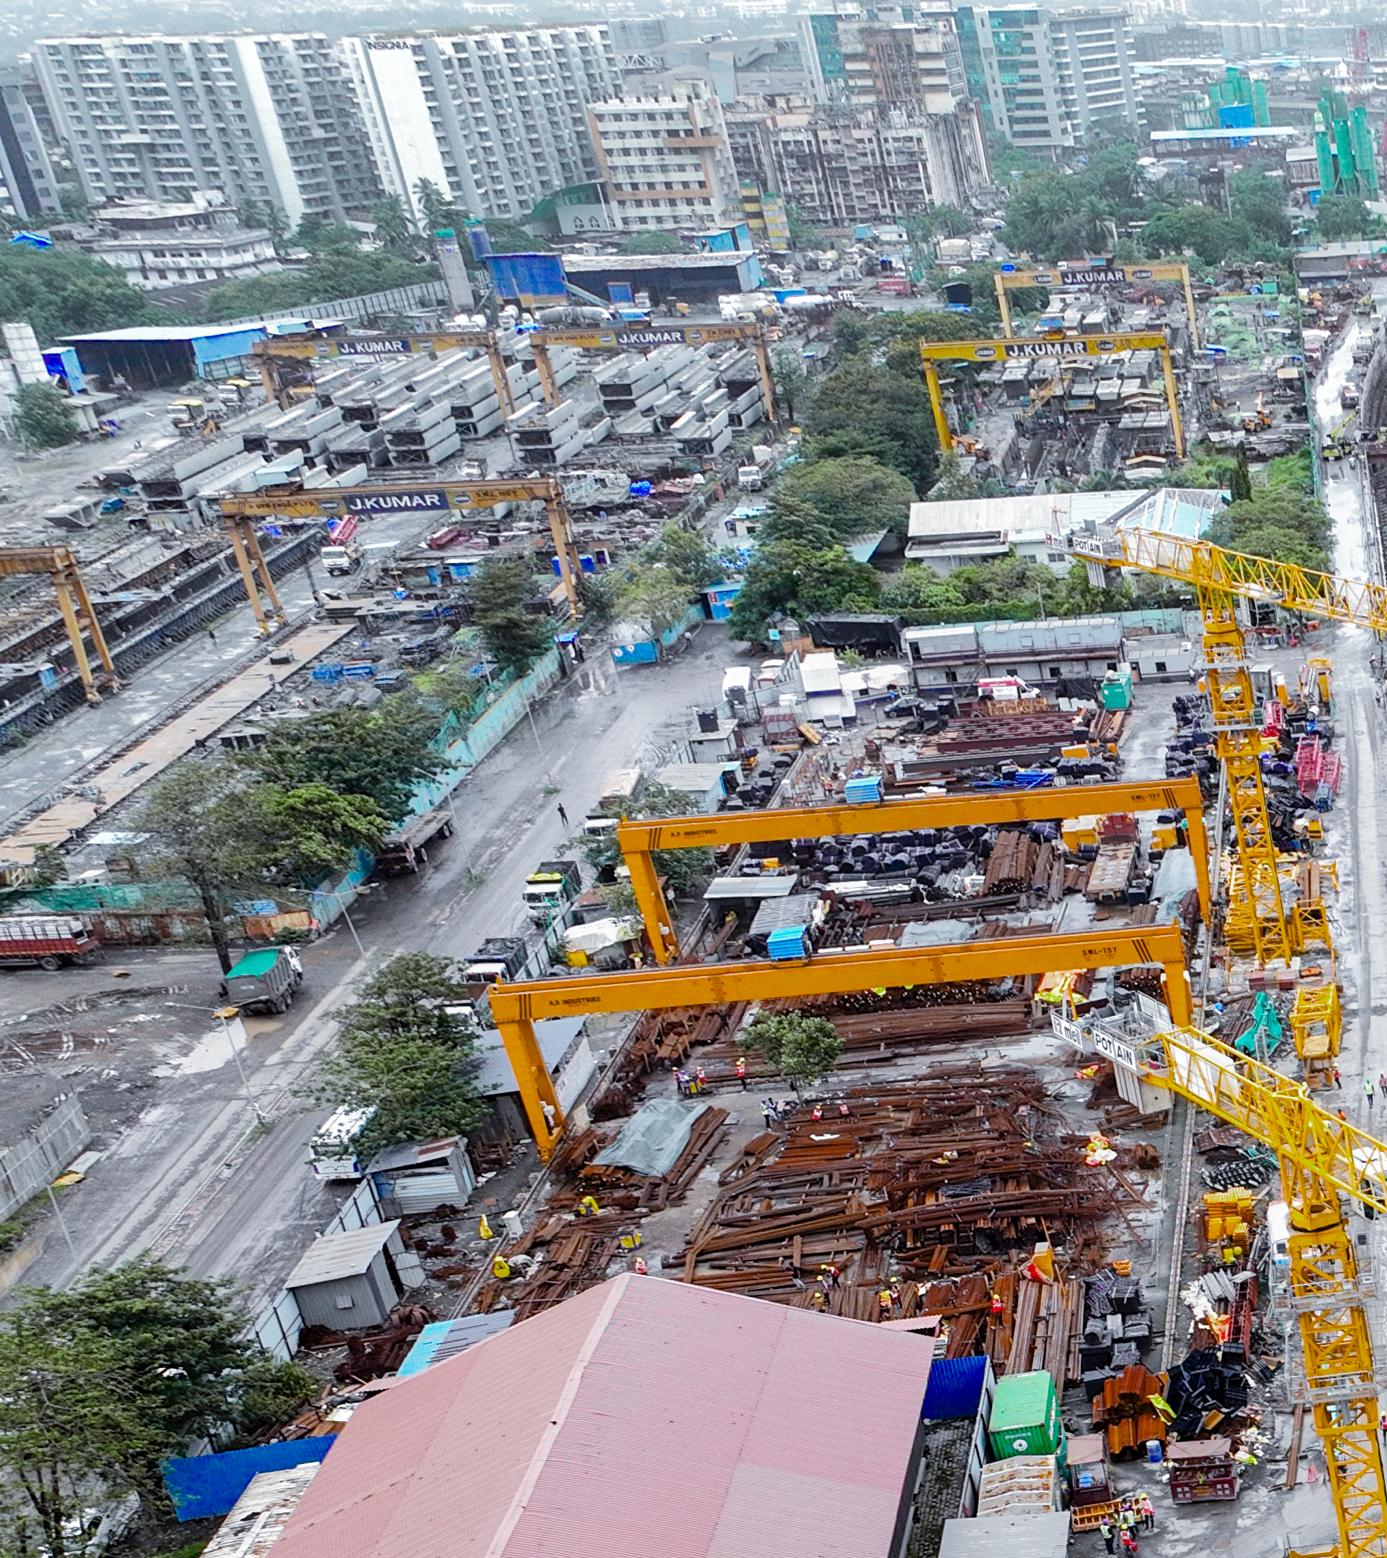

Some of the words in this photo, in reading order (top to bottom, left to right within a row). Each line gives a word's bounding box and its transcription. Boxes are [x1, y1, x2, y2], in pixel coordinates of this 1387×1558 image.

[1064, 270, 1125, 284] J.KUMAR
[618, 330, 683, 344] J.KUMAR
[357, 340, 405, 354] KUMAR
[1008, 341, 1085, 357] J.KUMAR
[349, 493, 441, 512] J.KUMAR
